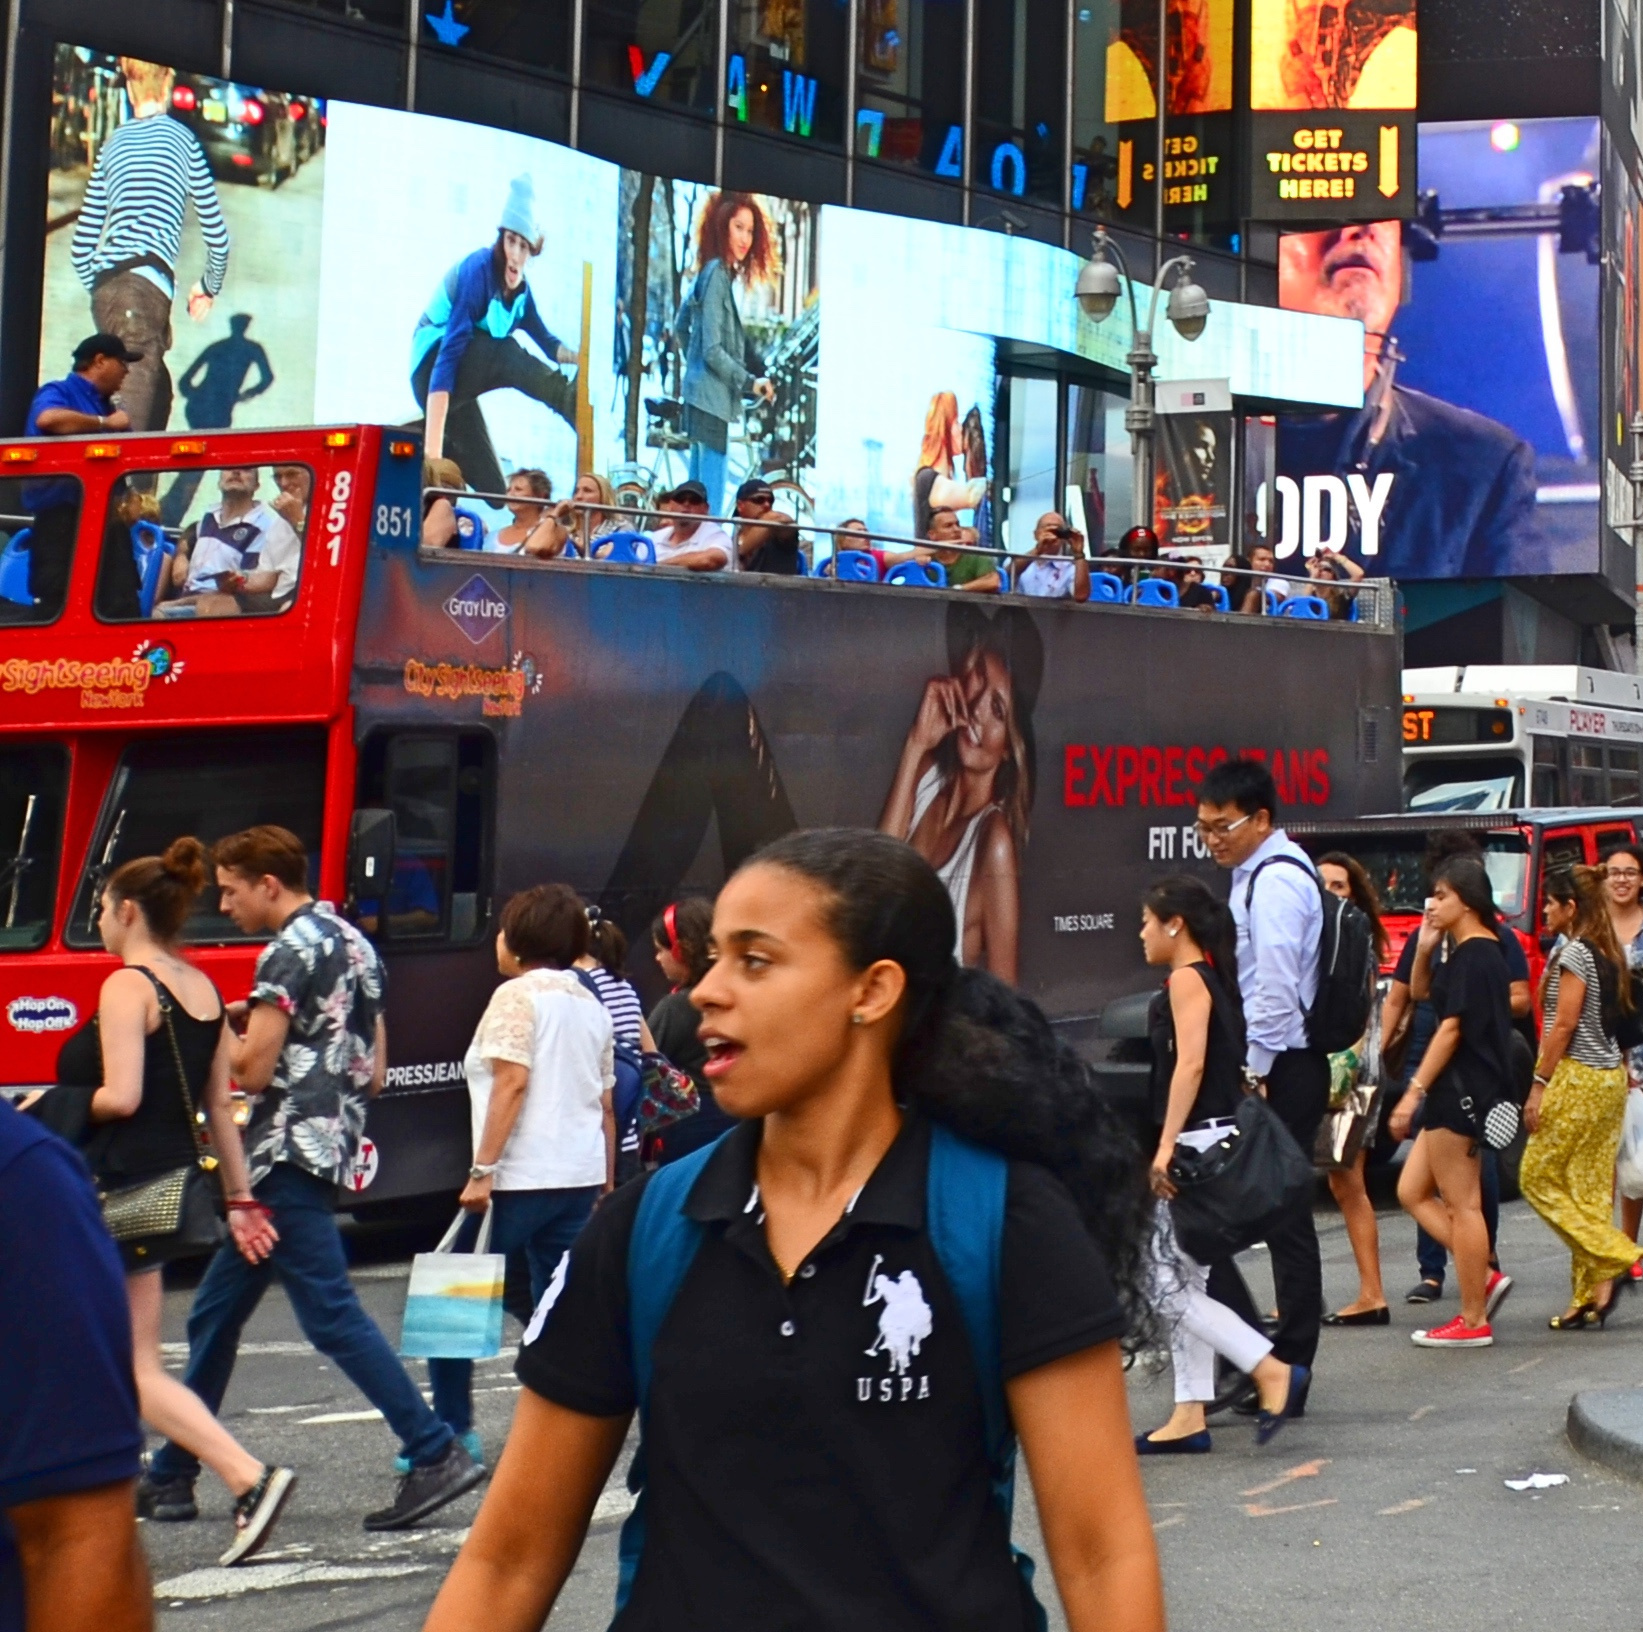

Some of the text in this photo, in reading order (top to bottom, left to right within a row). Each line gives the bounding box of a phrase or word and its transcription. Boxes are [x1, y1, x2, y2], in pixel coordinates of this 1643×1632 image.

[1293, 129, 1343, 149] GET
[1266, 151, 1368, 173] TICKETS
[1279, 177, 1355, 200] HERE!
[325, 471, 351, 567] 851
[376, 506, 412, 537] 851
[3, 658, 151, 693] Sightseeing
[437, 664, 525, 700] Sightseeing
[1403, 710, 1435, 741] ST
[1570, 709, 1606, 734] PLAYER
[1148, 827, 1212, 859] FIT FO
[1054, 912, 1115, 933] TIMES SQUARE
[18, 998, 65, 1015] Hop On
[18, 1017, 45, 1033] Hop
[382, 1061, 467, 1088] PRESSJEAN
